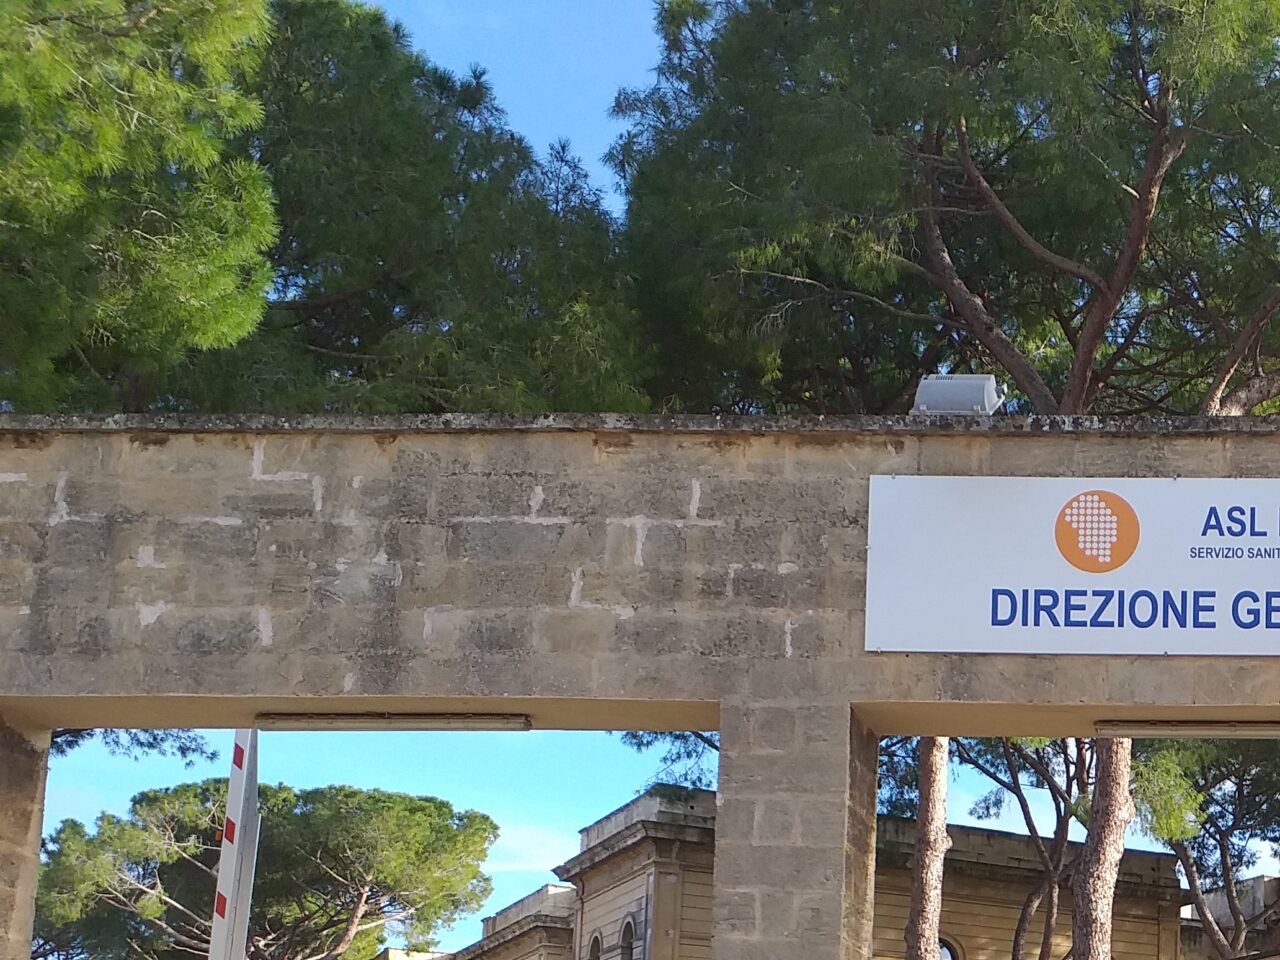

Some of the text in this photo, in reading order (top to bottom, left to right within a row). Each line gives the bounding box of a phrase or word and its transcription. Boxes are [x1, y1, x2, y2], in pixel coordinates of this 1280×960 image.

[1200, 506, 1267, 537] ASL
[1189, 546, 1244, 559] SERVIZIO
[990, 588, 1217, 629] DIREZIONE
